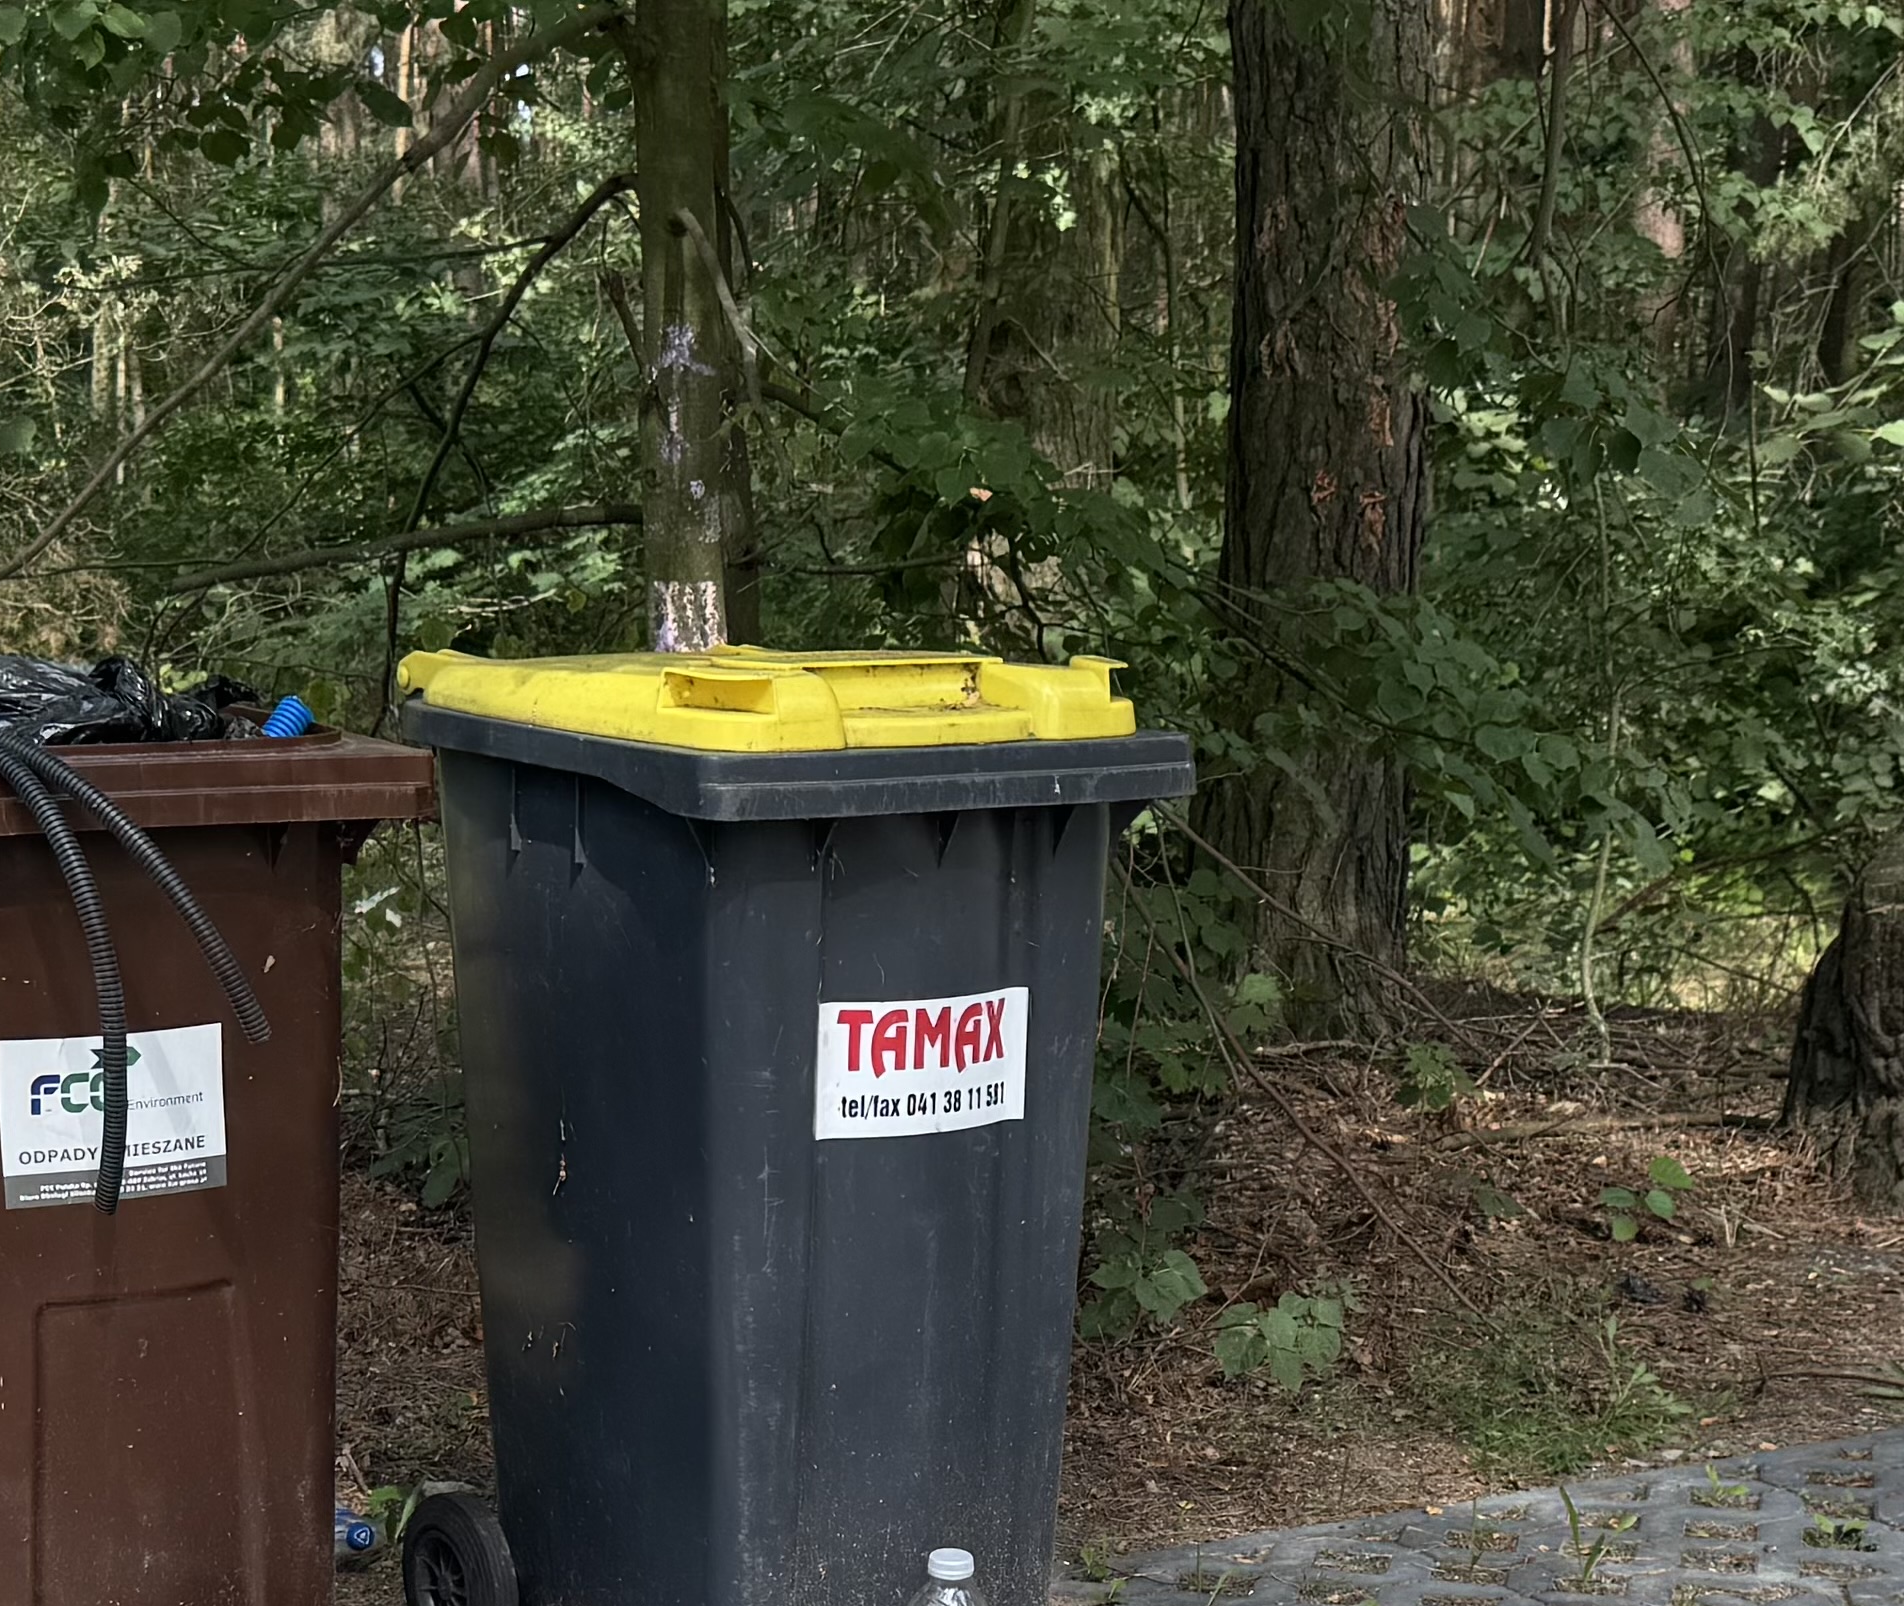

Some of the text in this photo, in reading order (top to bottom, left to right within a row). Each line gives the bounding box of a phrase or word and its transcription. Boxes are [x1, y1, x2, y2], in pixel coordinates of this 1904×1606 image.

[837, 997, 1005, 1078] TAMAX
[127, 1091, 204, 1111] Environment
[841, 1095, 900, 1119] tel/fax
[907, 1092, 937, 1116] 041
[943, 1089, 961, 1113] 38
[968, 1087, 981, 1110] 11
[19, 1147, 98, 1165] ODPADY
